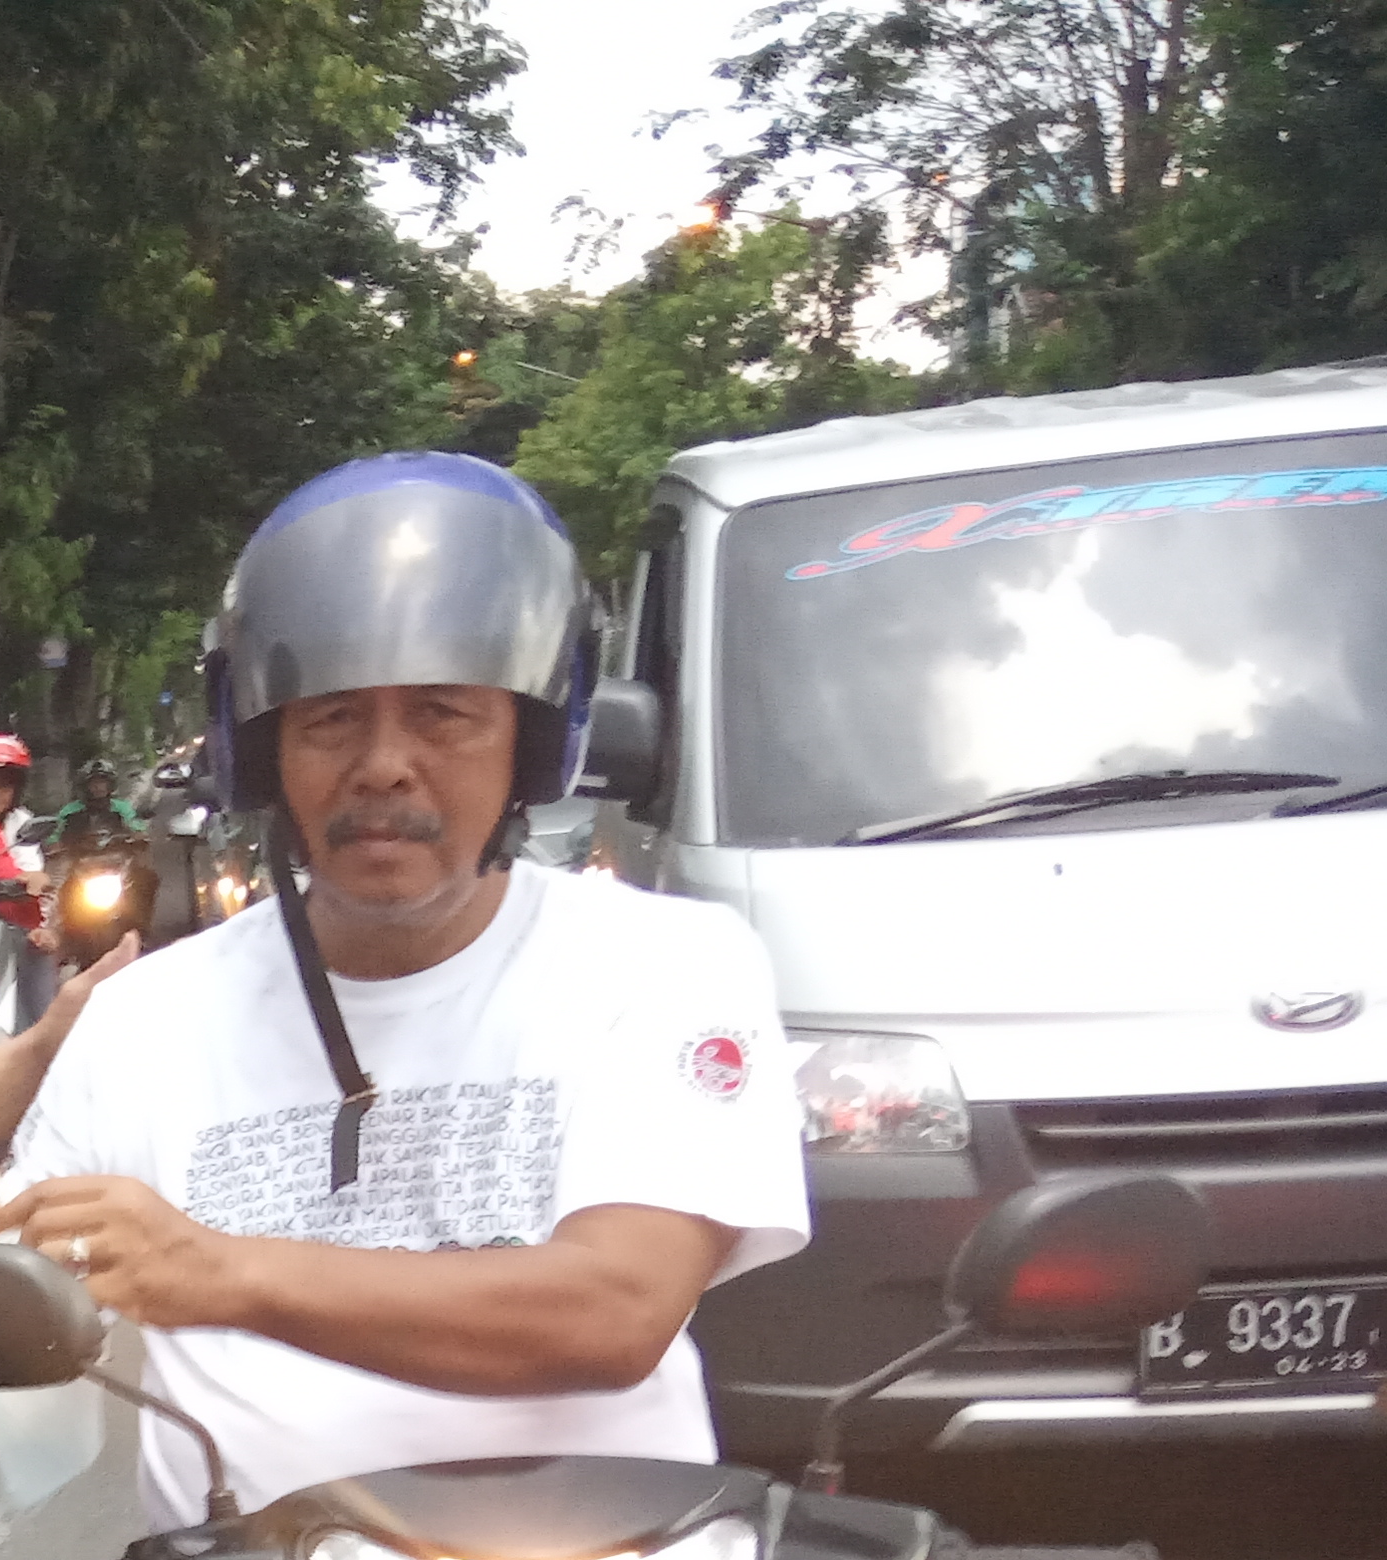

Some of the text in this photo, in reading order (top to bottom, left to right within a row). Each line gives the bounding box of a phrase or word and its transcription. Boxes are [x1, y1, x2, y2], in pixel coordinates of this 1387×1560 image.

[195, 1113, 269, 1147] SEBAGAI
[274, 1099, 340, 1127] ORANG
[389, 1081, 453, 1105] RAKYAT
[456, 1081, 503, 1102] ATAU
[236, 1127, 287, 1152] YANG
[278, 1143, 315, 1163] DAN
[236, 1201, 288, 1222] YAKIN
[293, 1189, 359, 1214] BAHWA
[470, 1173, 516, 1194] YANG
[302, 1210, 353, 1232] SUKA
[1226, 1295, 1356, 1353] 9337
